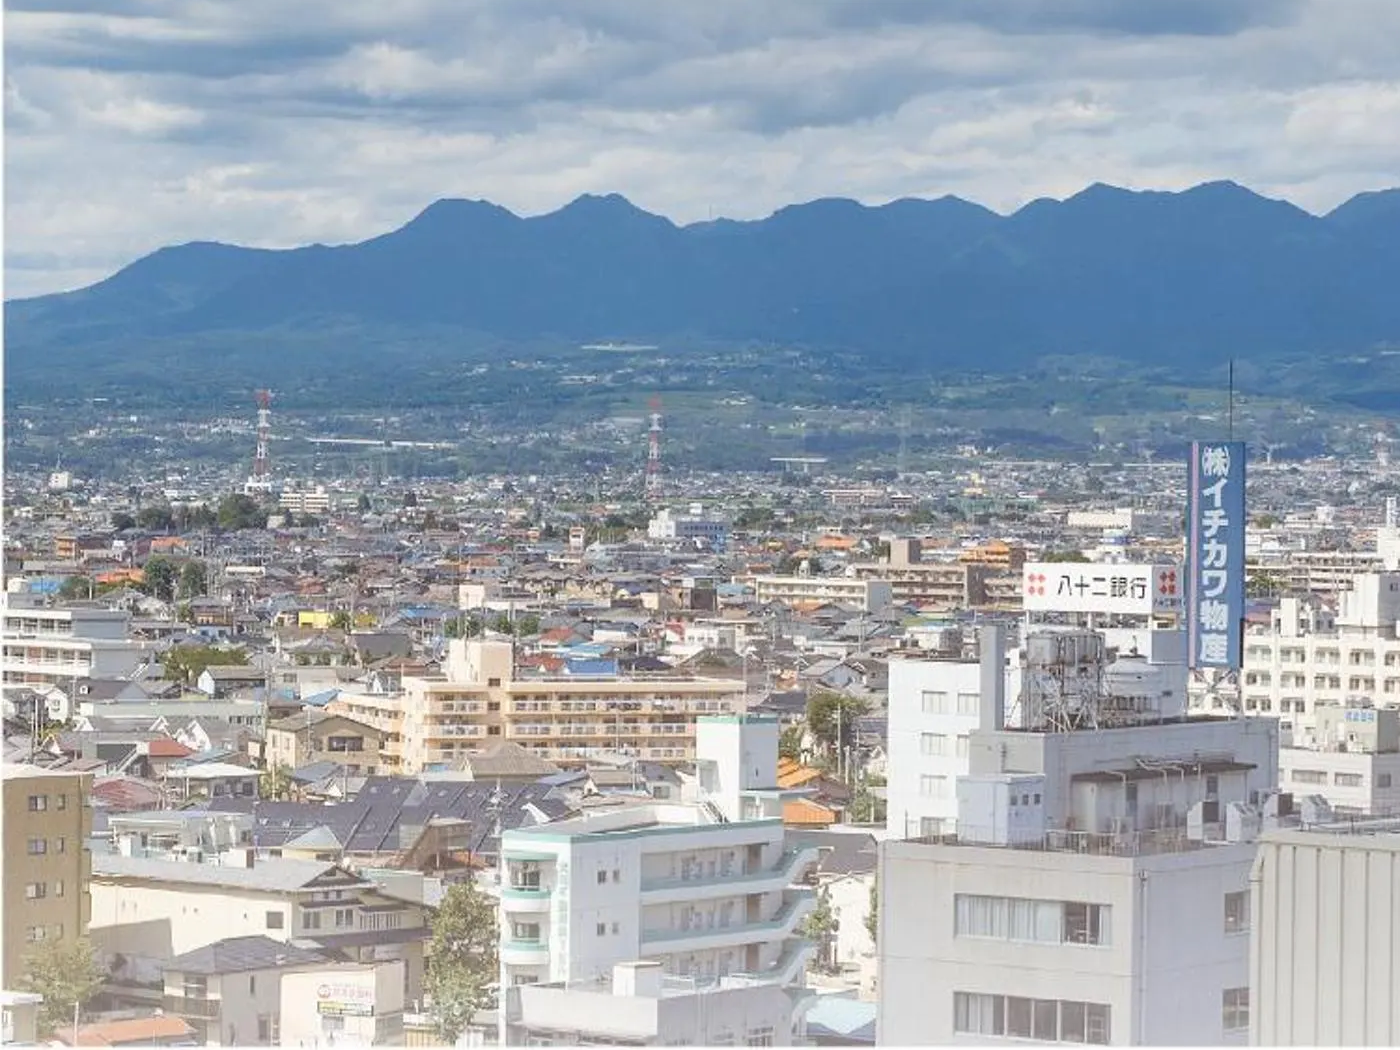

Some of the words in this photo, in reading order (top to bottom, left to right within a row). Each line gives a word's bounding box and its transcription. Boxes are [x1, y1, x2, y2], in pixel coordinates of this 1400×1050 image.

[1057, 574, 1147, 599] 八十二銀行
